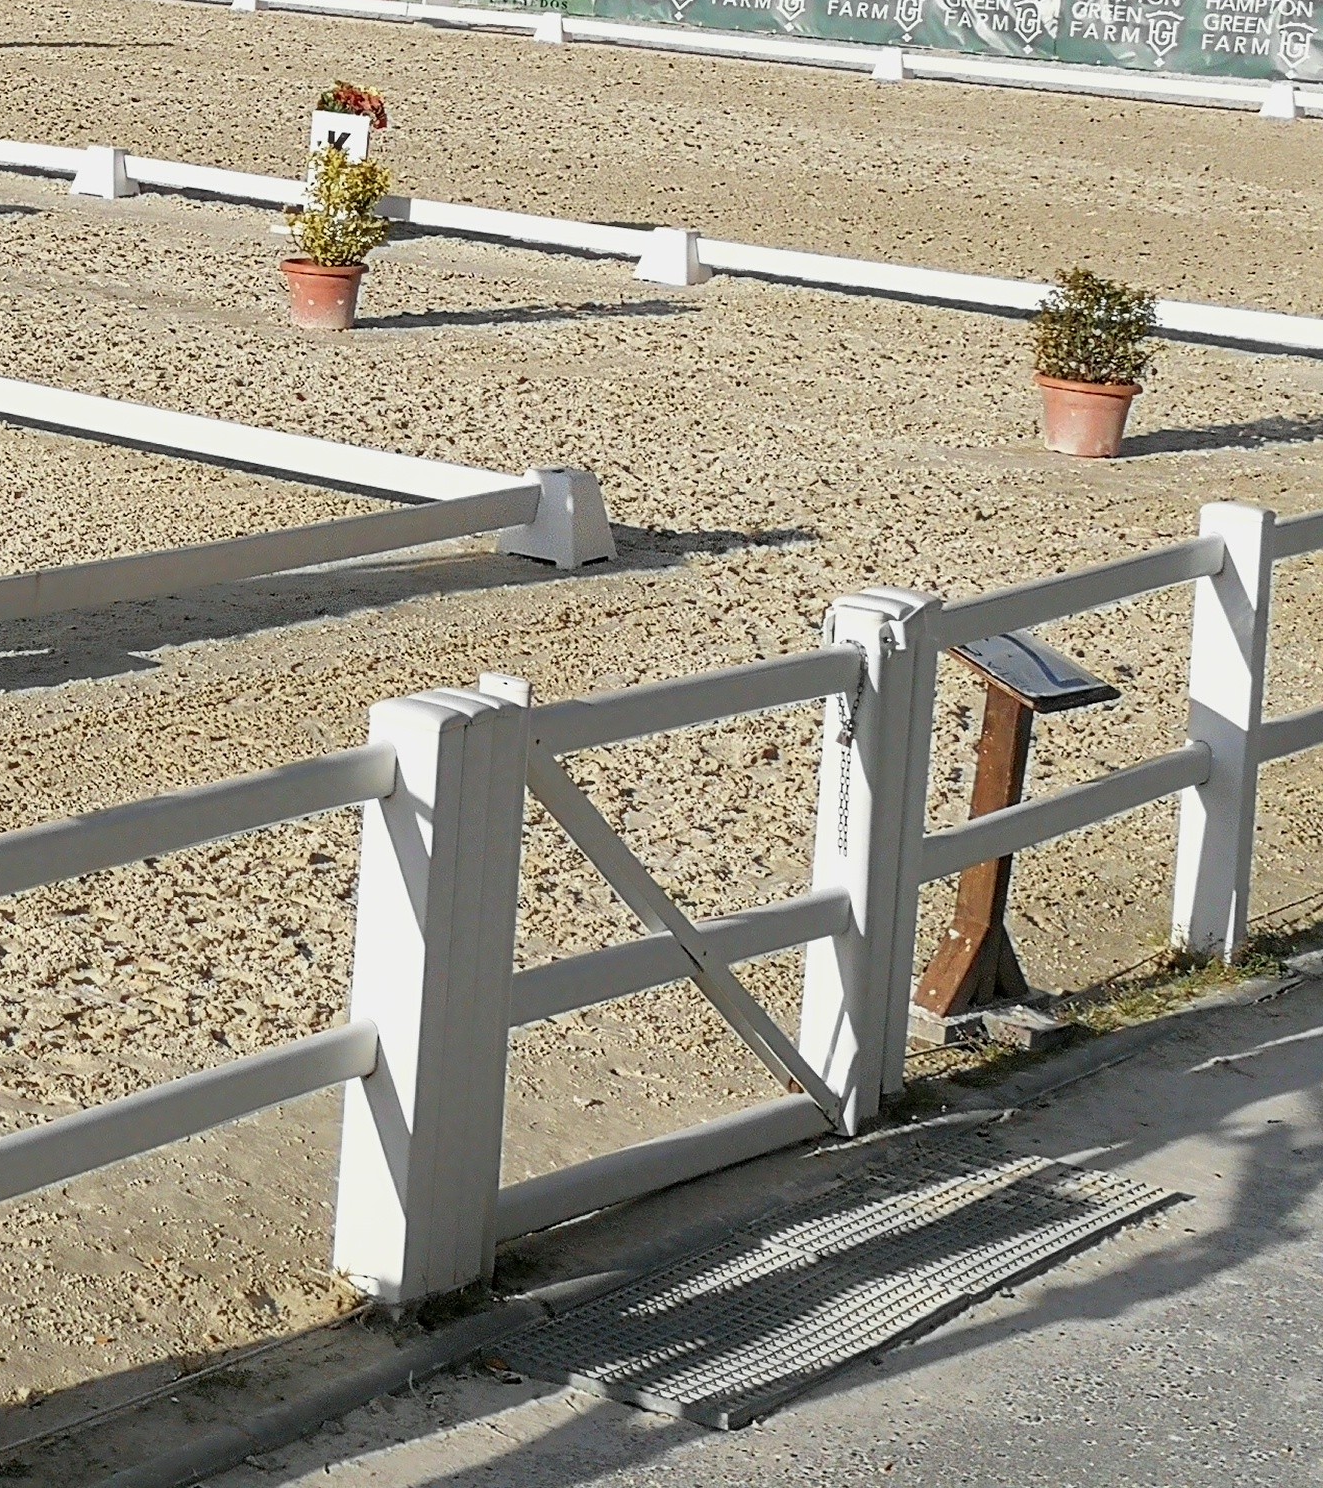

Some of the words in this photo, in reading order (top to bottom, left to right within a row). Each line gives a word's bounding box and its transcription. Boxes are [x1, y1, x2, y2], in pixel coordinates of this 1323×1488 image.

[827, 0, 888, 20] FARM
[1071, 1, 1143, 24] GREEN
[1070, 20, 1140, 44] FARM
[1203, 13, 1273, 35] GREEN
[1201, 33, 1270, 56] FARM
